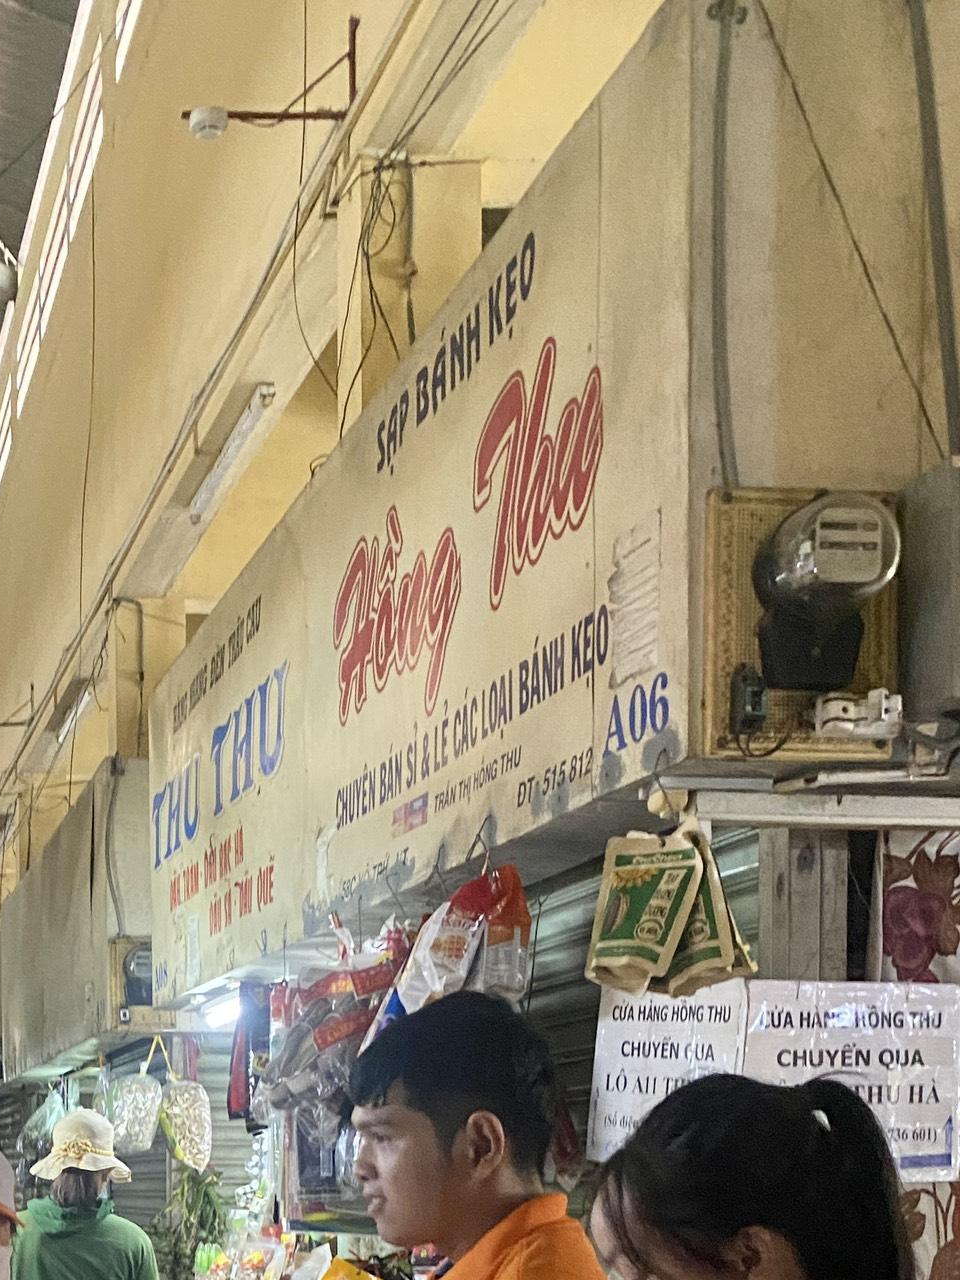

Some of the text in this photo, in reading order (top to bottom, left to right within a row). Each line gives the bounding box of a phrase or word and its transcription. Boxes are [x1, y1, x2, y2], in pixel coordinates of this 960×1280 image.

[376, 231, 536, 476] SẠP BÁNH KẸO
[333, 336, 603, 726] Hồng Thu
[246, 594, 262, 644] CAU
[336, 604, 609, 831] CHUYÊN BÁN SỈ & LẺ CÁC LOẠI BÁNH KẸO
[603, 672, 669, 758] A06
[500, 745, 522, 777] THU
[151, 753, 200, 871] THU
[671, 999, 704, 1023] HỒNG
[708, 1005, 731, 1023] THU
[909, 1011, 942, 1028] THU
[621, 1036, 679, 1060] CHUYỂN
[777, 1043, 925, 1071] CHUYỂN QUA
[605, 1068, 627, 1092] LÔ
[909, 1077, 940, 1104] HÀ
[912, 1127, 937, 1143] 601)
